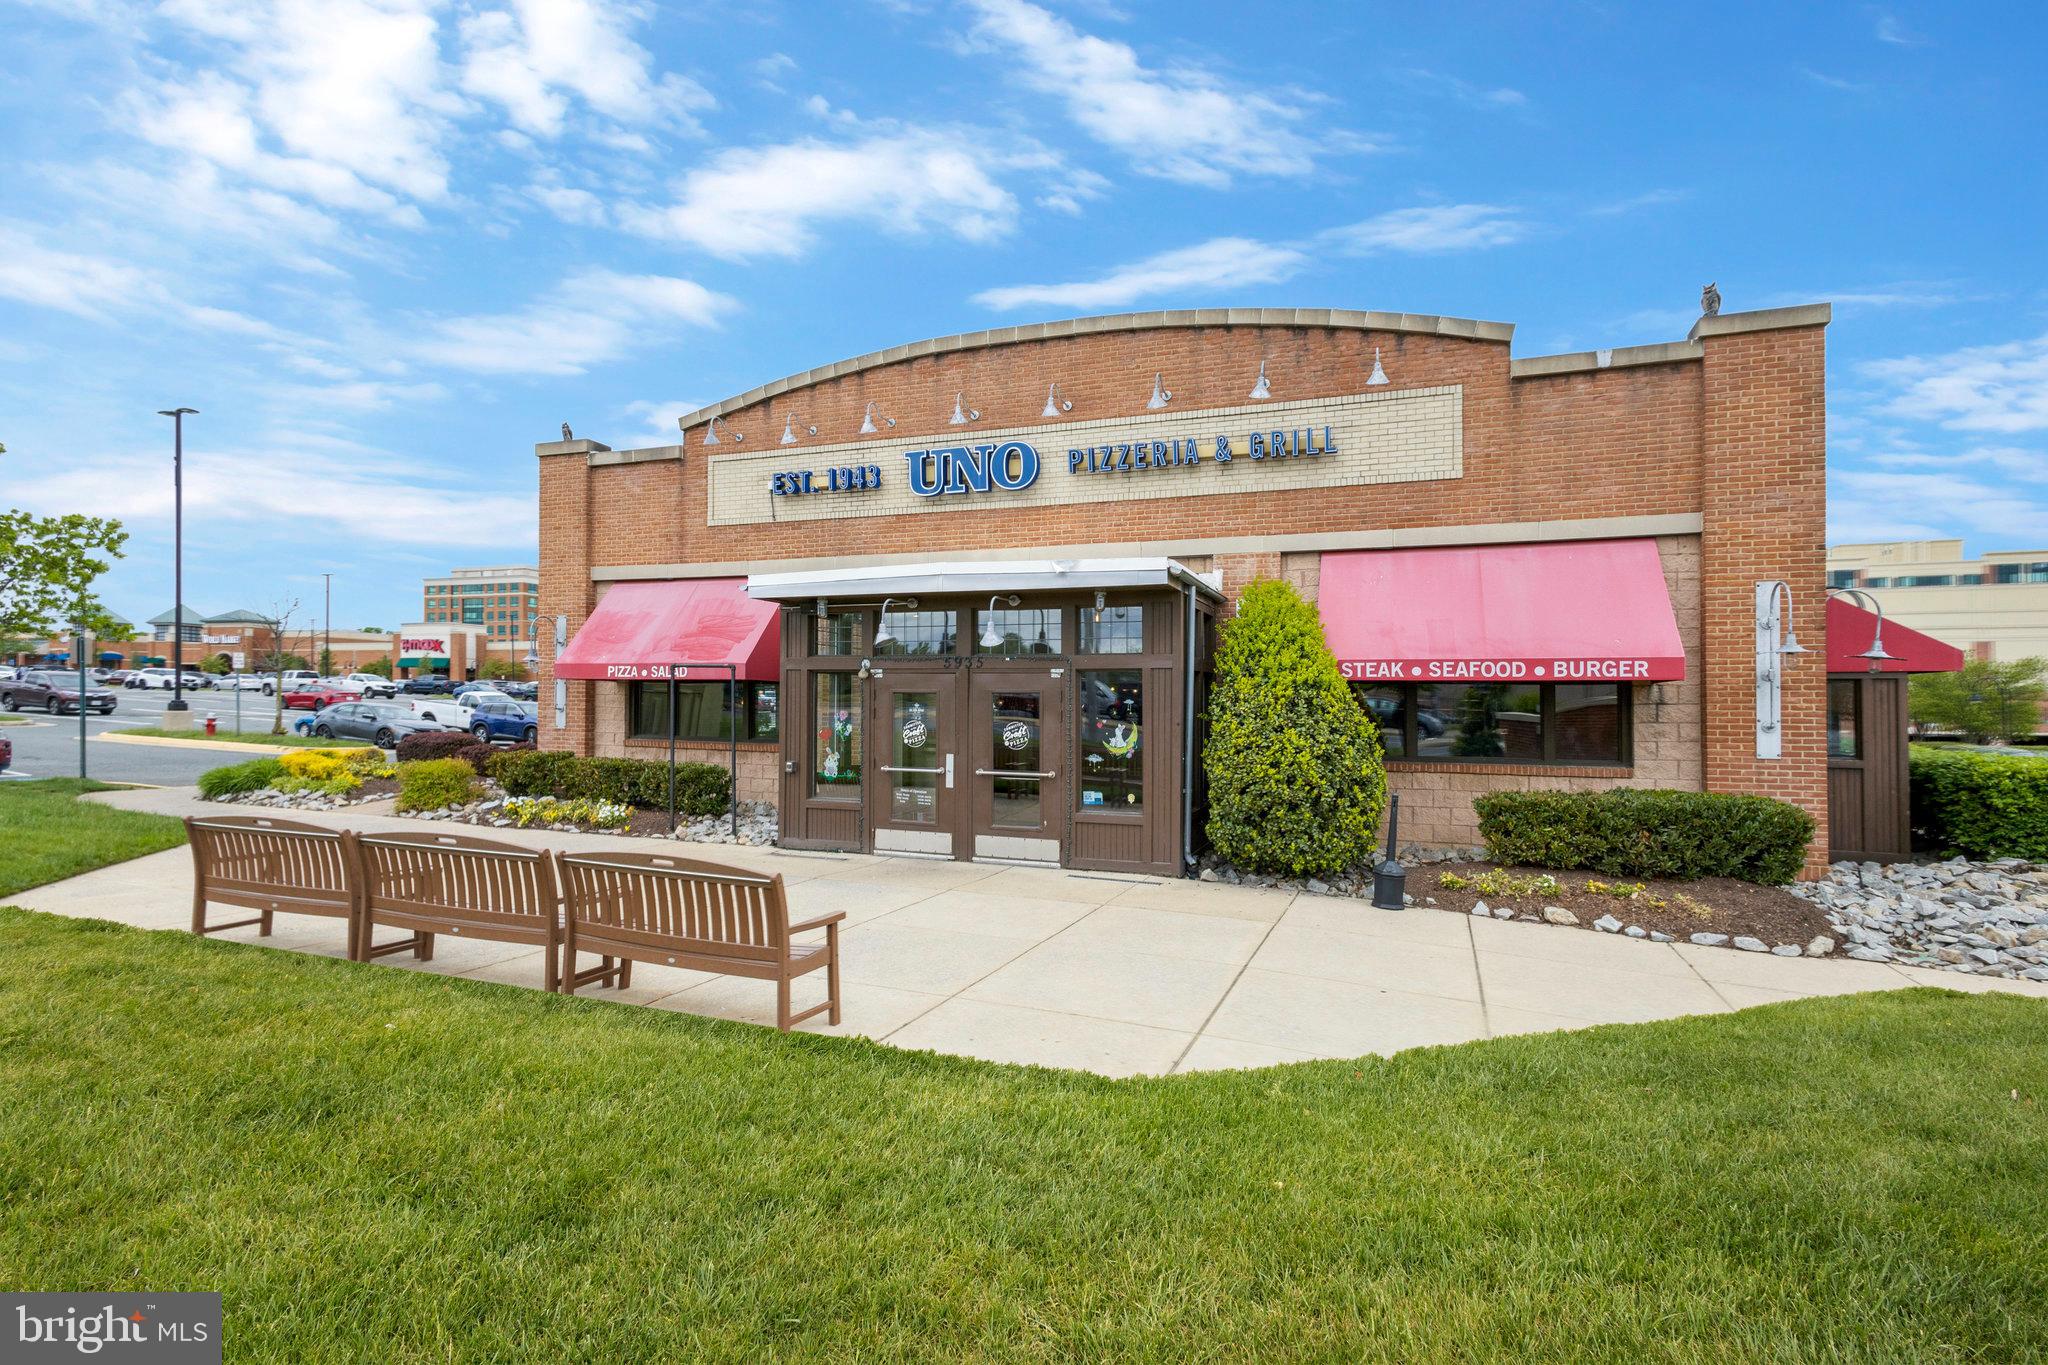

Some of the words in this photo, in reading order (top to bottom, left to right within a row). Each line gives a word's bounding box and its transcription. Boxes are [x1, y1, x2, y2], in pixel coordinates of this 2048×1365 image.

[1068, 437, 1199, 474] PIZZERIA
[1215, 435, 1232, 462] &
[1249, 425, 1338, 460] GRILL
[772, 470, 820, 496] EST.
[827, 464, 881, 491] 1943
[904, 441, 1040, 497] UNO
[607, 665, 638, 677] PIZZA
[943, 655, 984, 669] 5935
[1341, 663, 1404, 678] STEAK
[1429, 661, 1527, 678] SEAFOOD
[1553, 660, 1649, 678] BURGER
